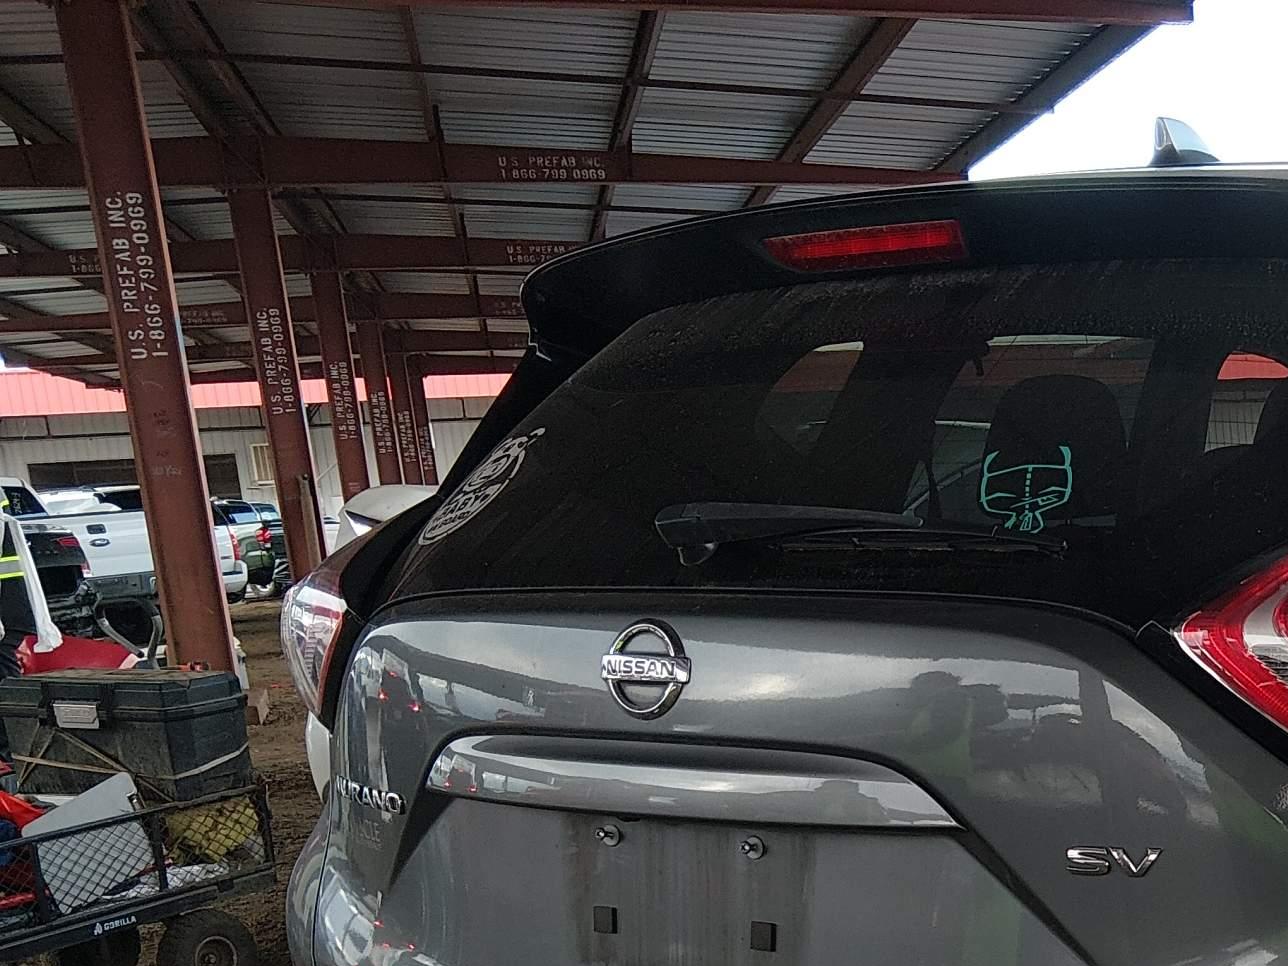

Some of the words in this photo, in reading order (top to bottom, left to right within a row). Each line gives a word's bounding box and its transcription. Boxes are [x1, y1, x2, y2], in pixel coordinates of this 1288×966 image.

[528, 156, 577, 168] PREFAB
[105, 191, 127, 228] INC.
[112, 238, 141, 313] PREFAB
[125, 192, 169, 357] 1-866-799-0969
[256, 307, 270, 333] INC.
[128, 323, 148, 360] U.S.
[260, 336, 281, 386] PREFAB
[271, 390, 285, 416] U.S.
[332, 380, 346, 420] PREFAB
[606, 658, 676, 677] NISSAN
[1066, 846, 1162, 878] SV
[104, 915, 137, 931] GORILLA
